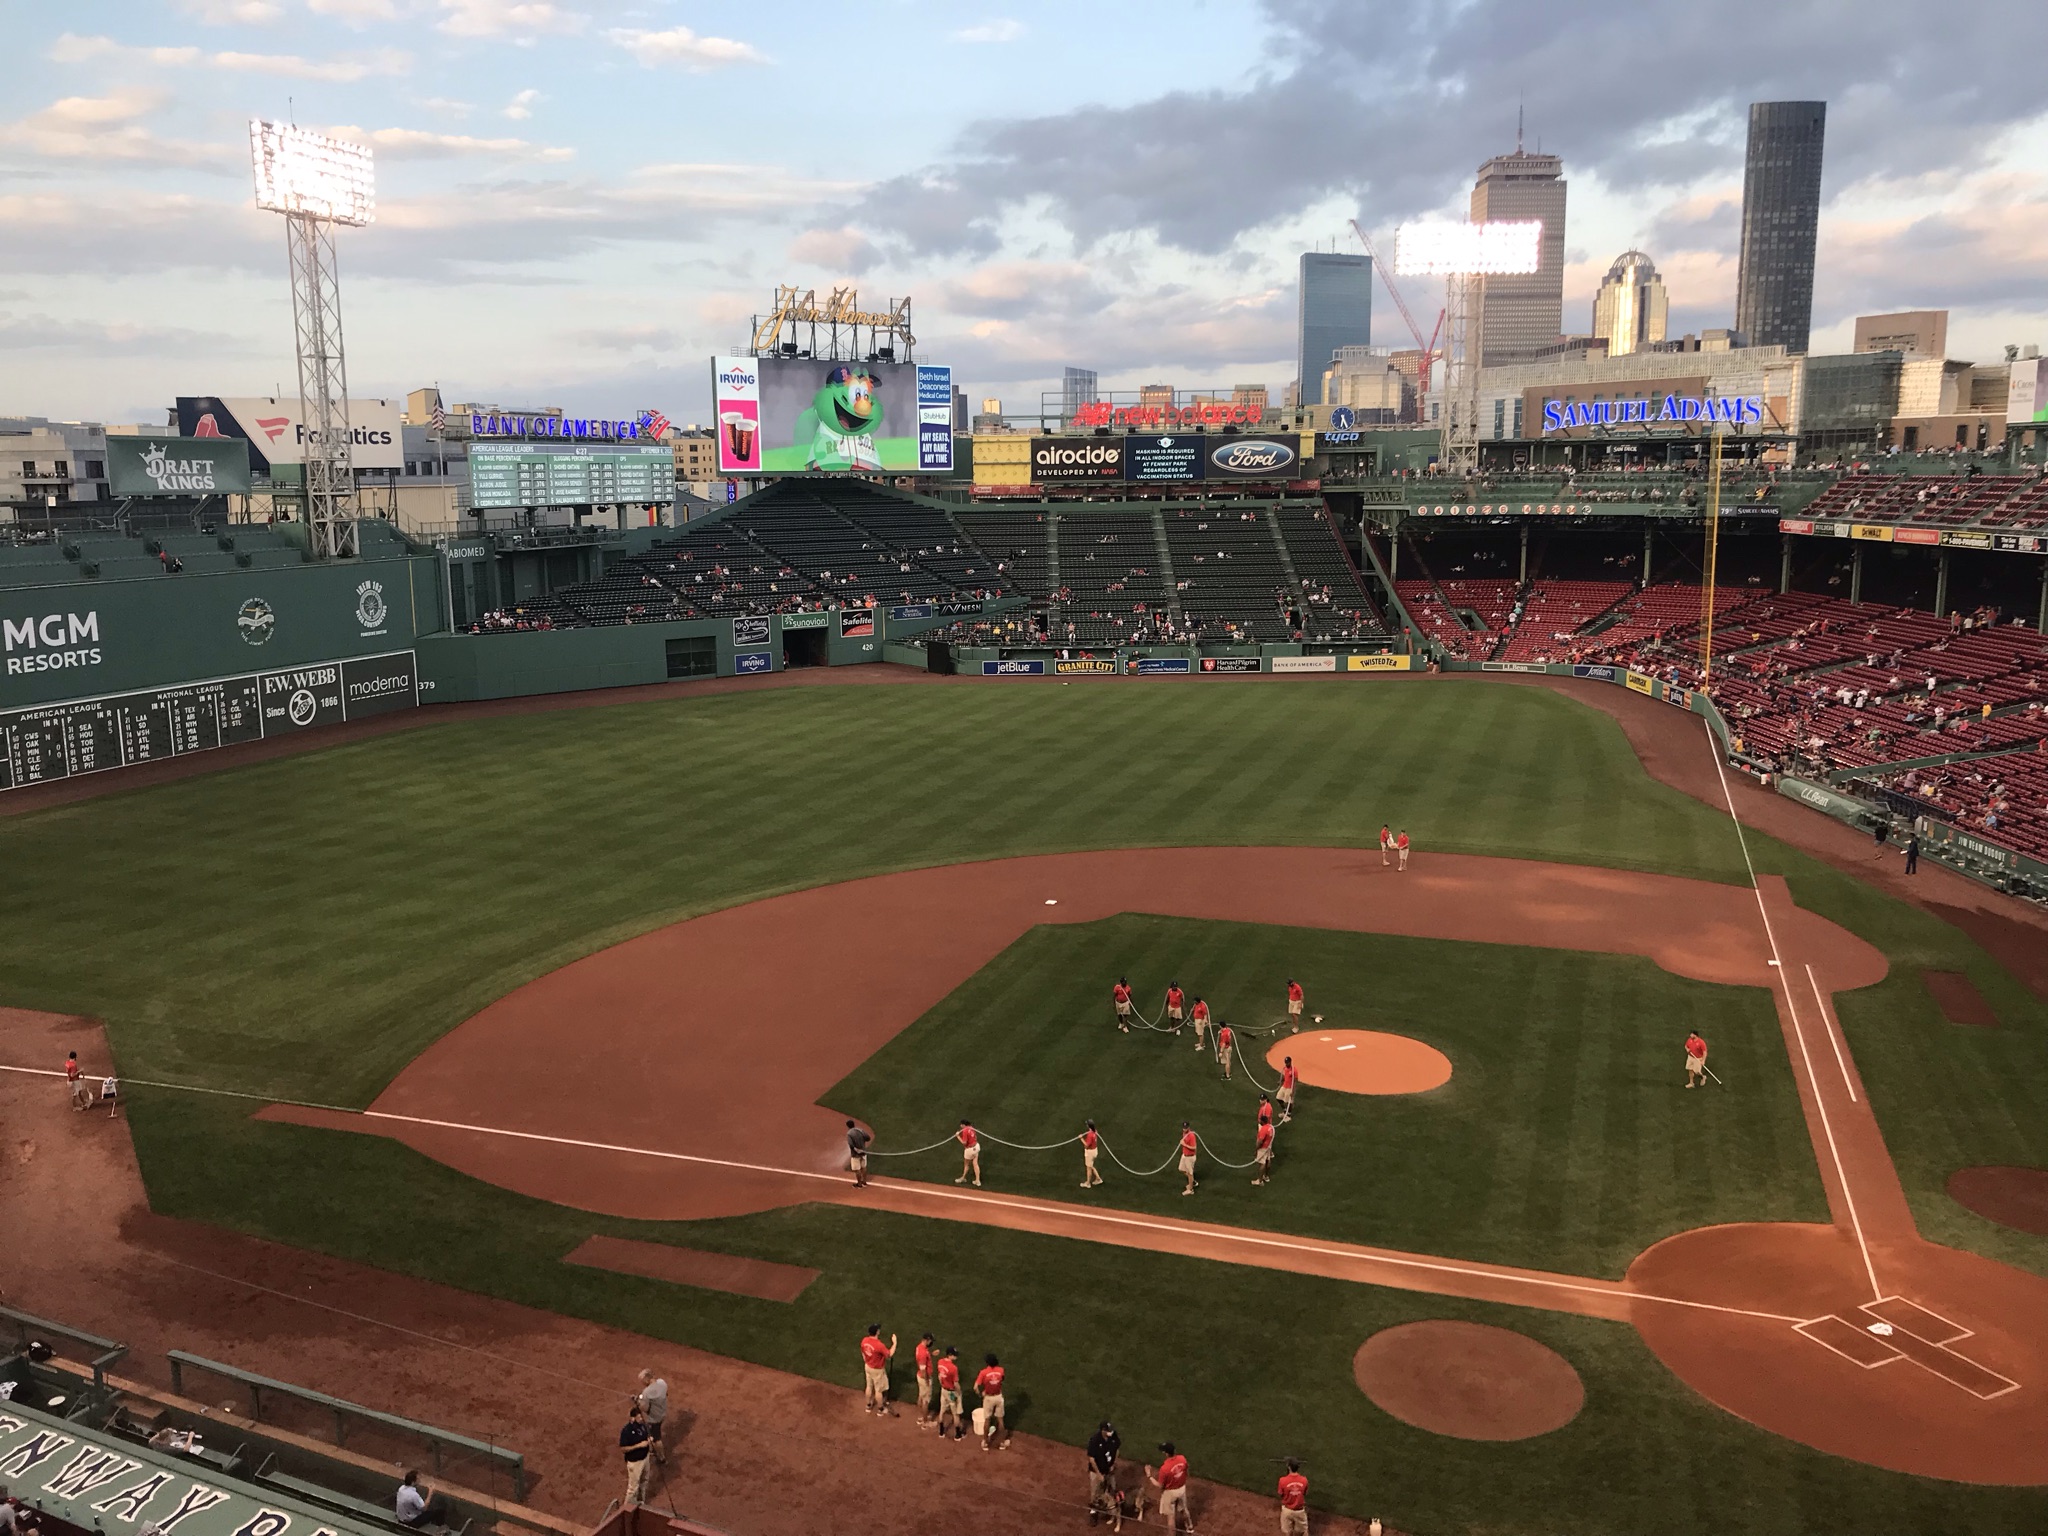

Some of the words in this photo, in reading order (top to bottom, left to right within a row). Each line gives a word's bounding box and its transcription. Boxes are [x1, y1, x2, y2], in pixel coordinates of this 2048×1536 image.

[754, 284, 820, 350] John
[821, 286, 917, 346] Hancock
[720, 374, 755, 384] IRVING
[920, 372, 933, 381] Beth
[934, 373, 950, 381] Israel
[919, 382, 950, 391] Deaconess
[1114, 407, 1162, 425] new
[1164, 401, 1263, 425] balance
[1543, 395, 1654, 432] SAMUEL
[1658, 394, 1762, 425] ADAMS
[472, 415, 528, 436] BANK
[534, 416, 556, 436] OF
[560, 418, 639, 439] AMERICA
[922, 433, 932, 442] ANY
[932, 433, 950, 442] SEATS,
[1324, 432, 1360, 444] tyco
[922, 443, 933, 452] ANY
[933, 443, 949, 453] GAME,
[1036, 446, 1118, 465] airocide
[924, 454, 935, 463] ANY
[935, 454, 947, 463] TIME
[1228, 446, 1278, 466] Ford
[146, 458, 214, 479] DRAFT
[157, 476, 216, 490] KINGS
[448, 546, 485, 558] ABIOMED
[356, 580, 371, 596] IBEW
[792, 618, 826, 627] sunovion
[842, 617, 872, 626] Safelite
[3, 611, 99, 651] MGM
[7, 648, 102, 675] RESORTS
[742, 659, 765, 668] IRVING
[997, 662, 1030, 674] jetBlue
[1057, 662, 1094, 672] GRANITE
[1096, 661, 1115, 671] CITY
[1360, 658, 1386, 668] TWISTED
[1386, 658, 1398, 667] TEA
[264, 674, 293, 695] F.W.
[294, 667, 336, 688] WEBB
[350, 674, 408, 696] moderna
[418, 681, 436, 690] 379
[157, 691, 193, 700] NATIONAL
[196, 684, 224, 694] LEAGUE
[20, 708, 65, 721] AMERICAN
[70, 703, 102, 714] LEAGUE
[266, 707, 285, 718] Since
[320, 696, 338, 708] 1866
[1969, 840, 1983, 853] BEAM
[1984, 846, 2006, 862] DUGOUT
